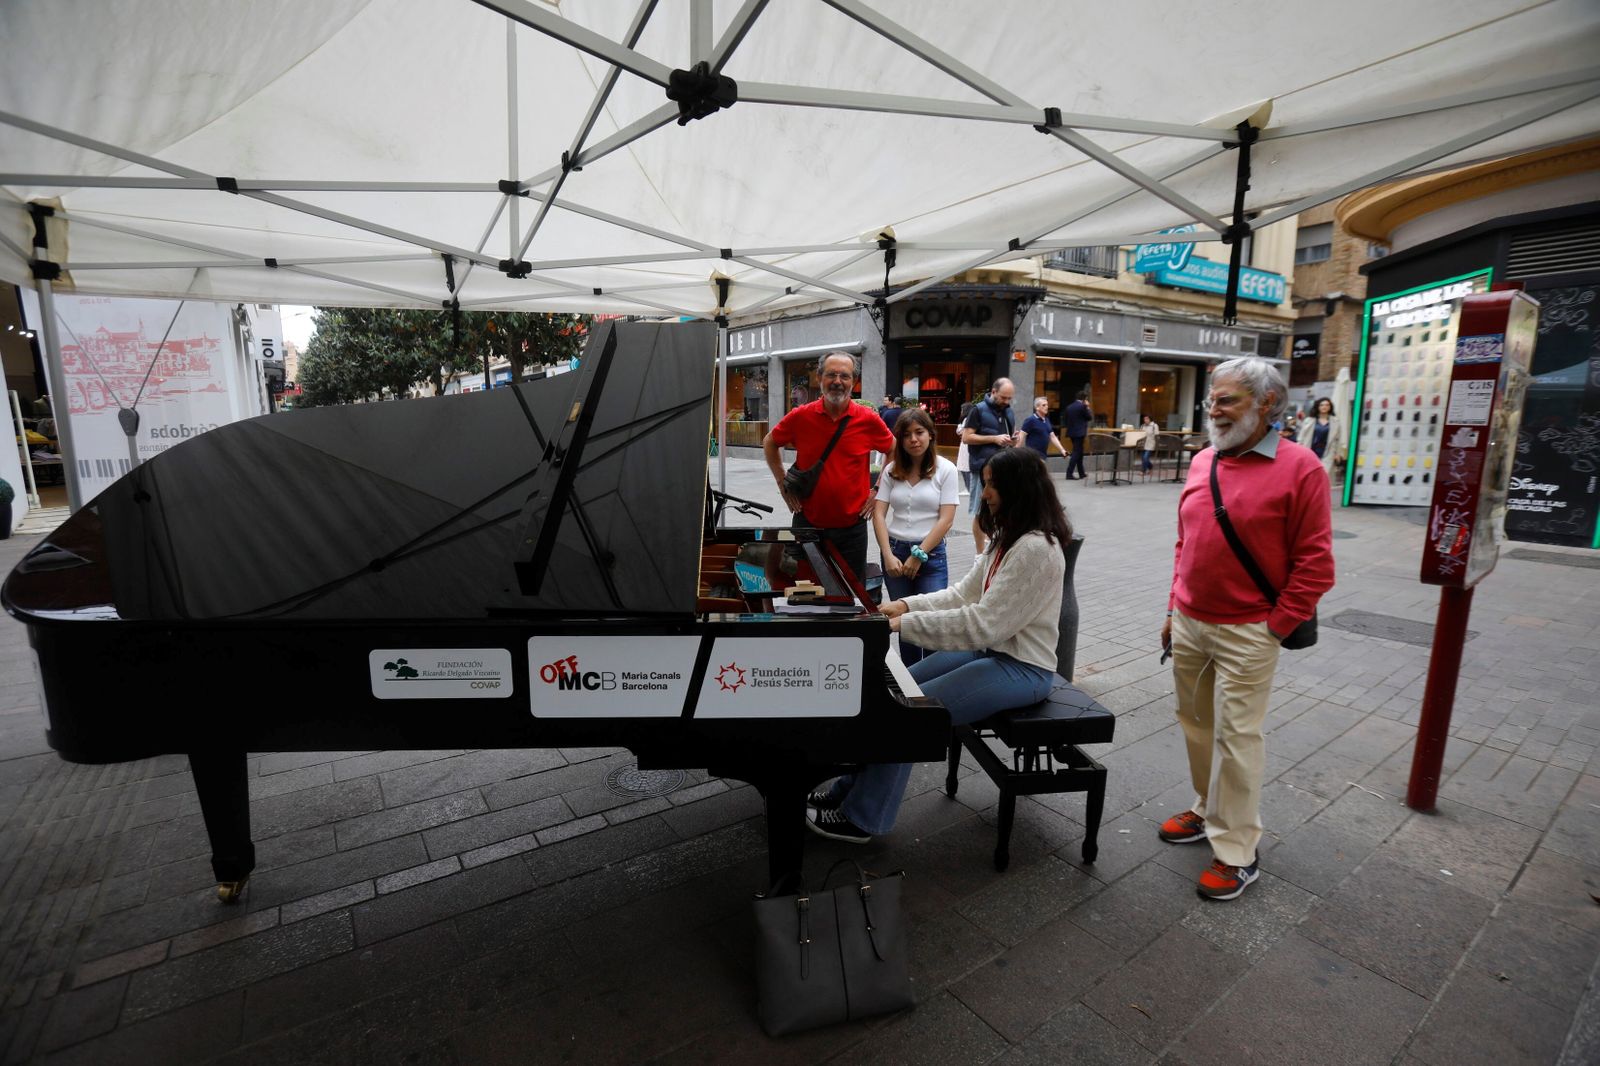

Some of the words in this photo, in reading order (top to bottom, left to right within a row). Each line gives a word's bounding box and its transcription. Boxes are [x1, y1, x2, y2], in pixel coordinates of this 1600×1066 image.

[1241, 272, 1284, 300] EFETA
[905, 305, 992, 329] COVAP
[447, 670, 473, 678] Delgado
[540, 655, 578, 684] OFF
[751, 667, 810, 678] Fundación
[825, 664, 850, 681] 25
[558, 671, 617, 691] MCB
[621, 672, 648, 680] Maria
[650, 672, 681, 680] Canals
[470, 681, 501, 689] COVAP
[622, 682, 668, 690] Barcelona
[750, 678, 782, 688] Jesús
[783, 678, 813, 688] Serra
[824, 682, 850, 690] años
